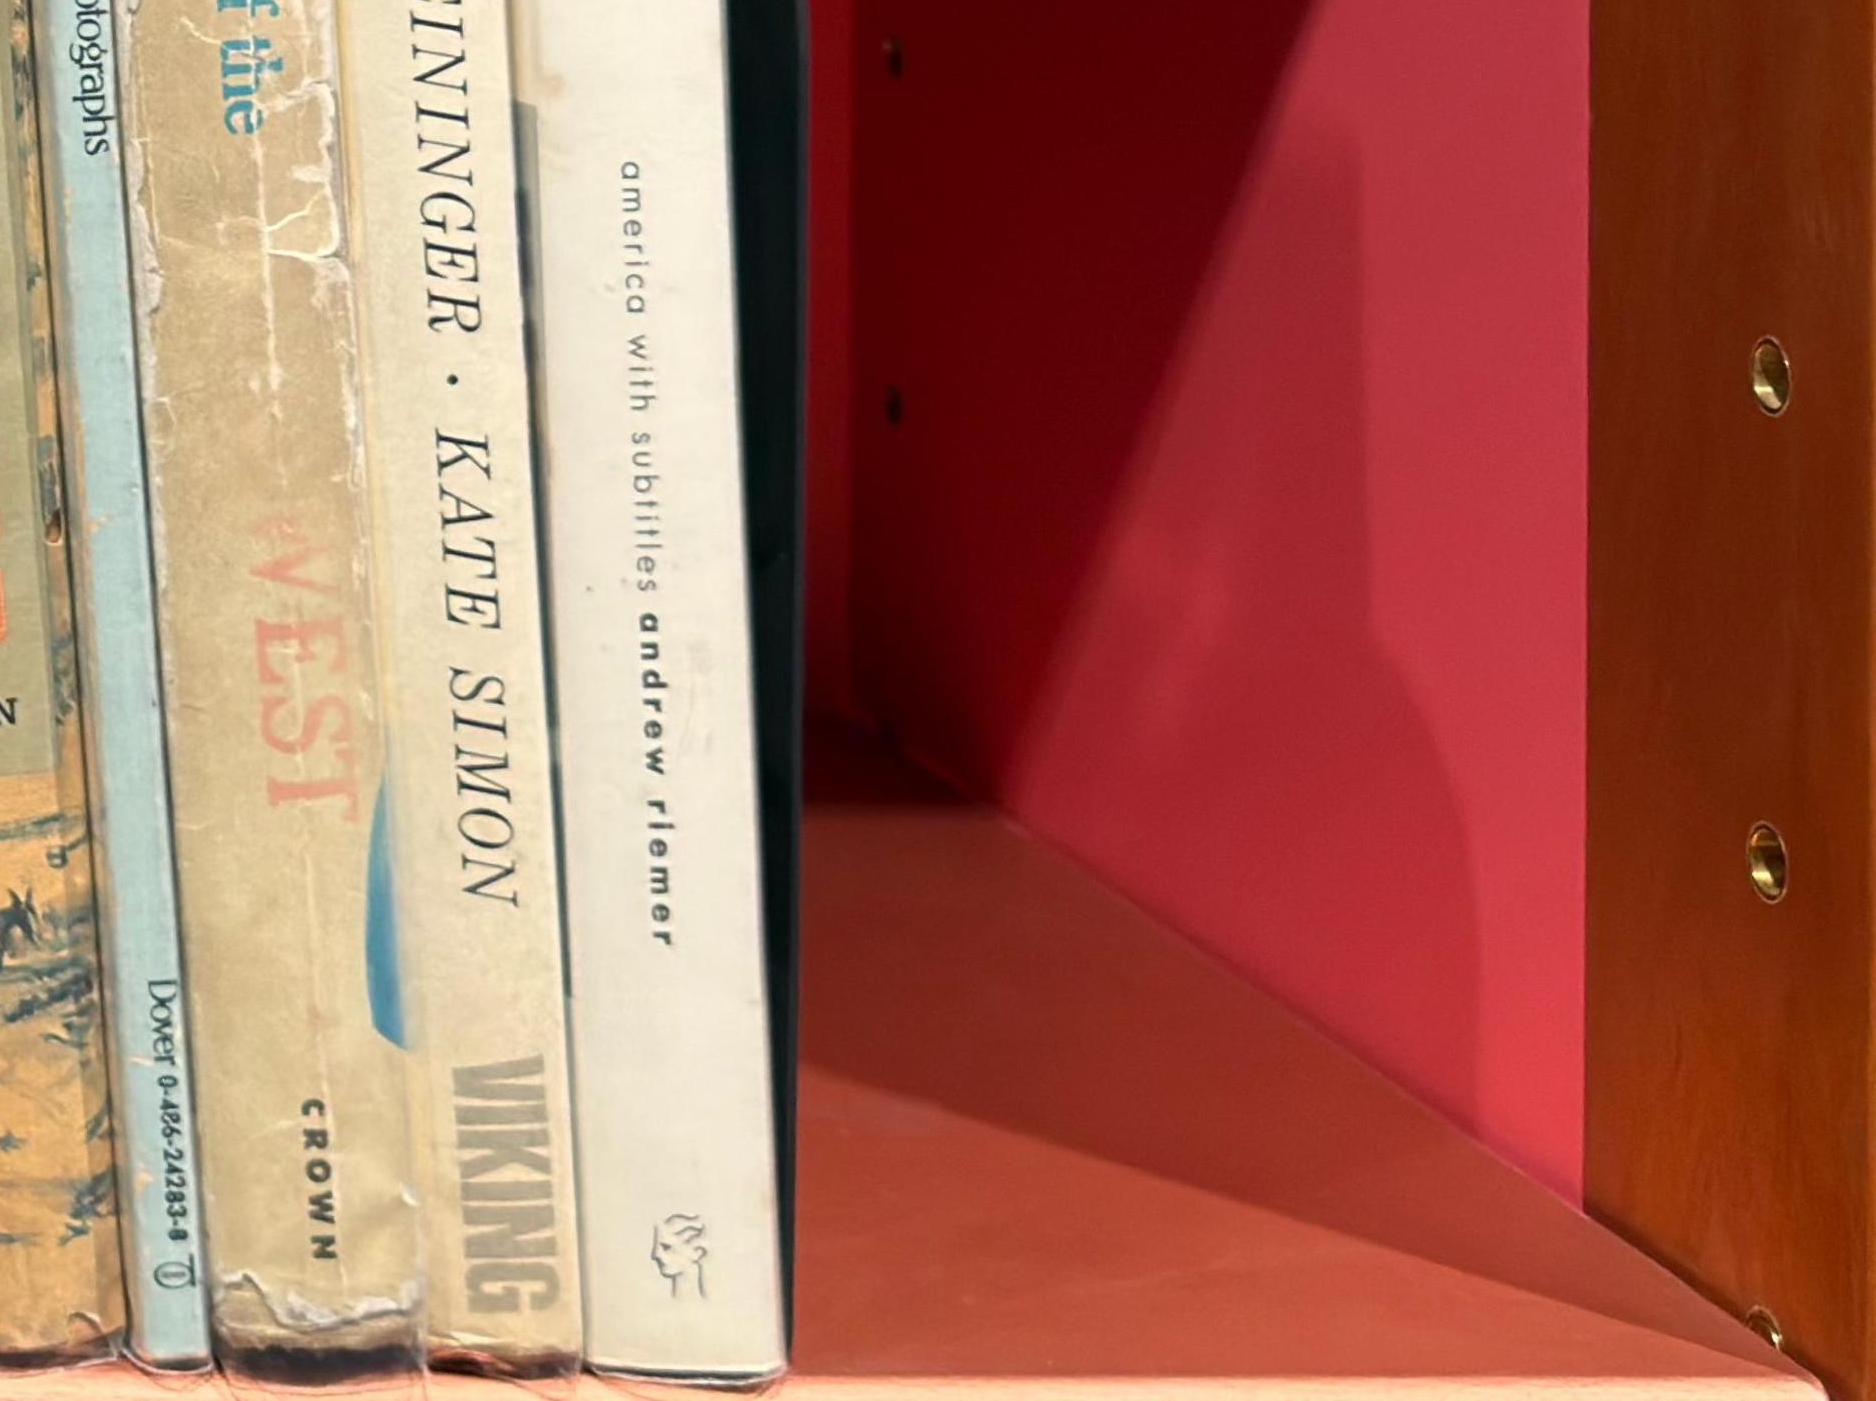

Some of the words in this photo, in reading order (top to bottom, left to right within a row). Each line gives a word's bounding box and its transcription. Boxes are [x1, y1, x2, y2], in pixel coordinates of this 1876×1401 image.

[219, 36, 284, 136] the
[620, 160, 650, 314] america
[628, 334, 656, 411] with
[435, 425, 503, 633] KATE
[631, 431, 663, 592] subtitles
[248, 512, 360, 823] WEST
[638, 611, 668, 776] andrew
[449, 664, 519, 909] SIMON
[646, 798, 675, 947] riemer
[148, 979, 178, 1066] Dover
[301, 1099, 338, 1260] CROWN
[450, 1054, 561, 1317] VIKING
